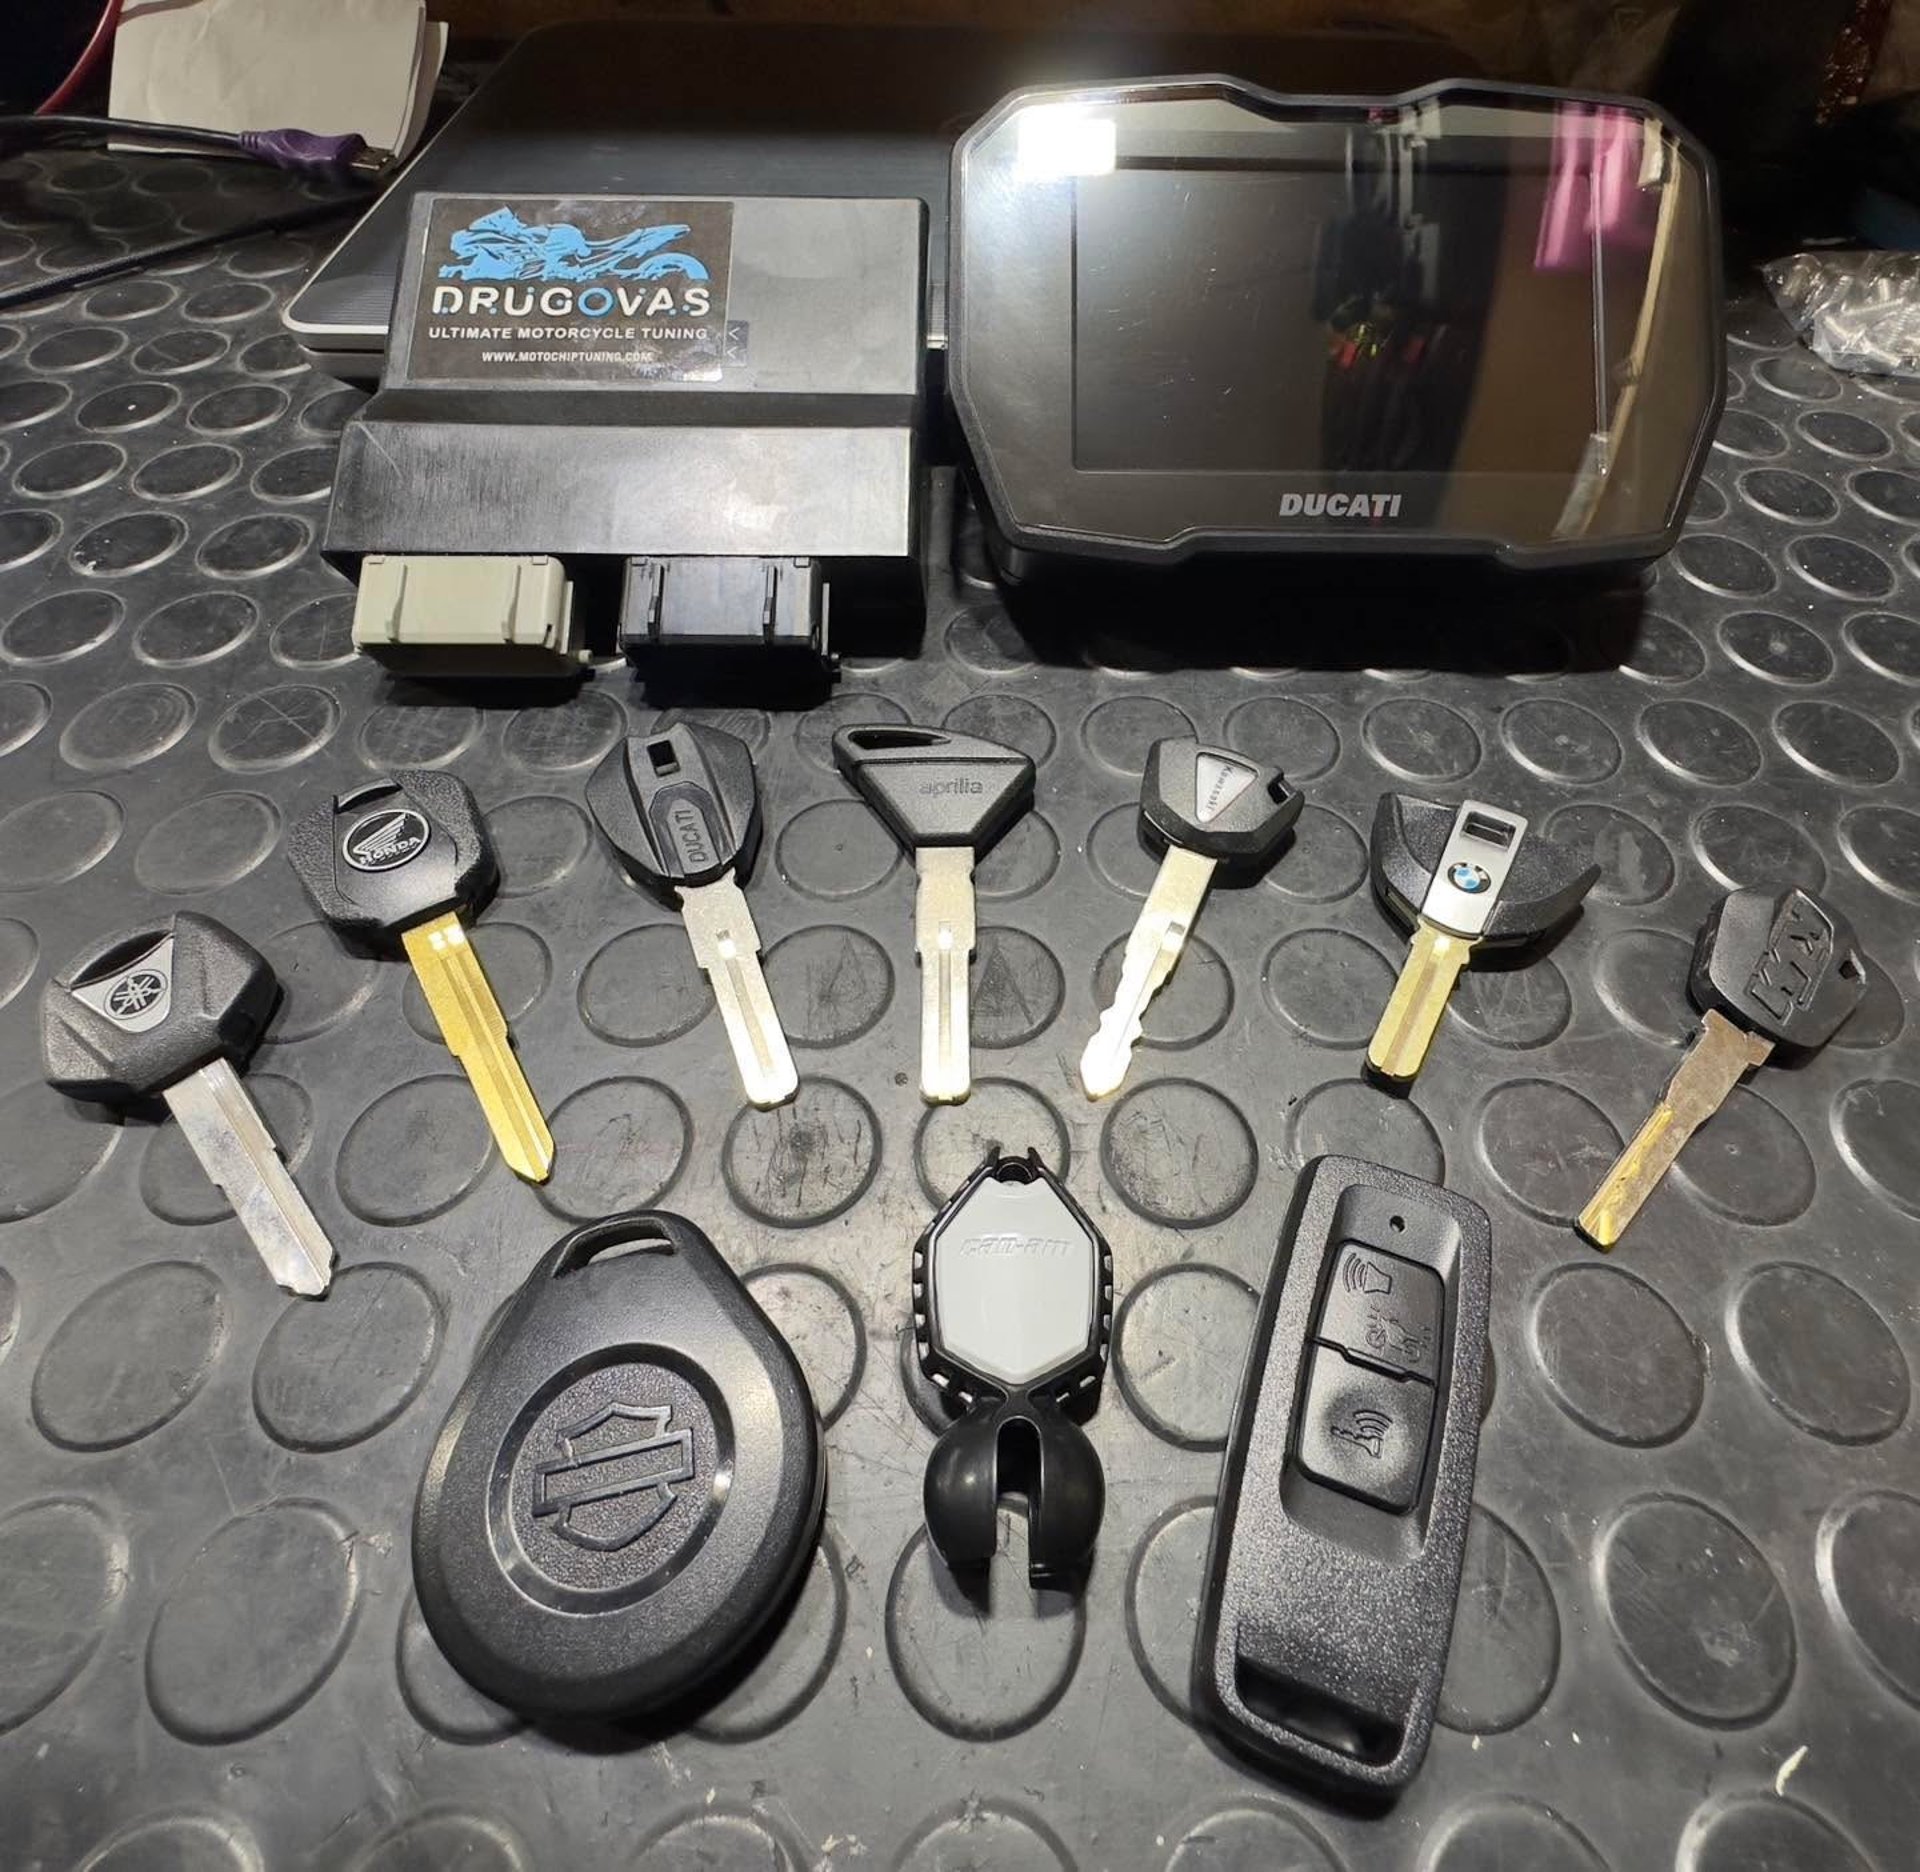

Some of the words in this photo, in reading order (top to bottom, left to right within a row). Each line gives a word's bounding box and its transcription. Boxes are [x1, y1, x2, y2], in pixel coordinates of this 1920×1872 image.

[432, 287, 711, 317] DRUGOVAS
[429, 327, 512, 340] ULTIMATE
[517, 327, 635, 340] MOTORCYCLE
[641, 328, 707, 340] TUNING
[1279, 493, 1402, 517] DUCATI
[919, 777, 983, 797] aprilia
[674, 809, 709, 863] DUCATI
